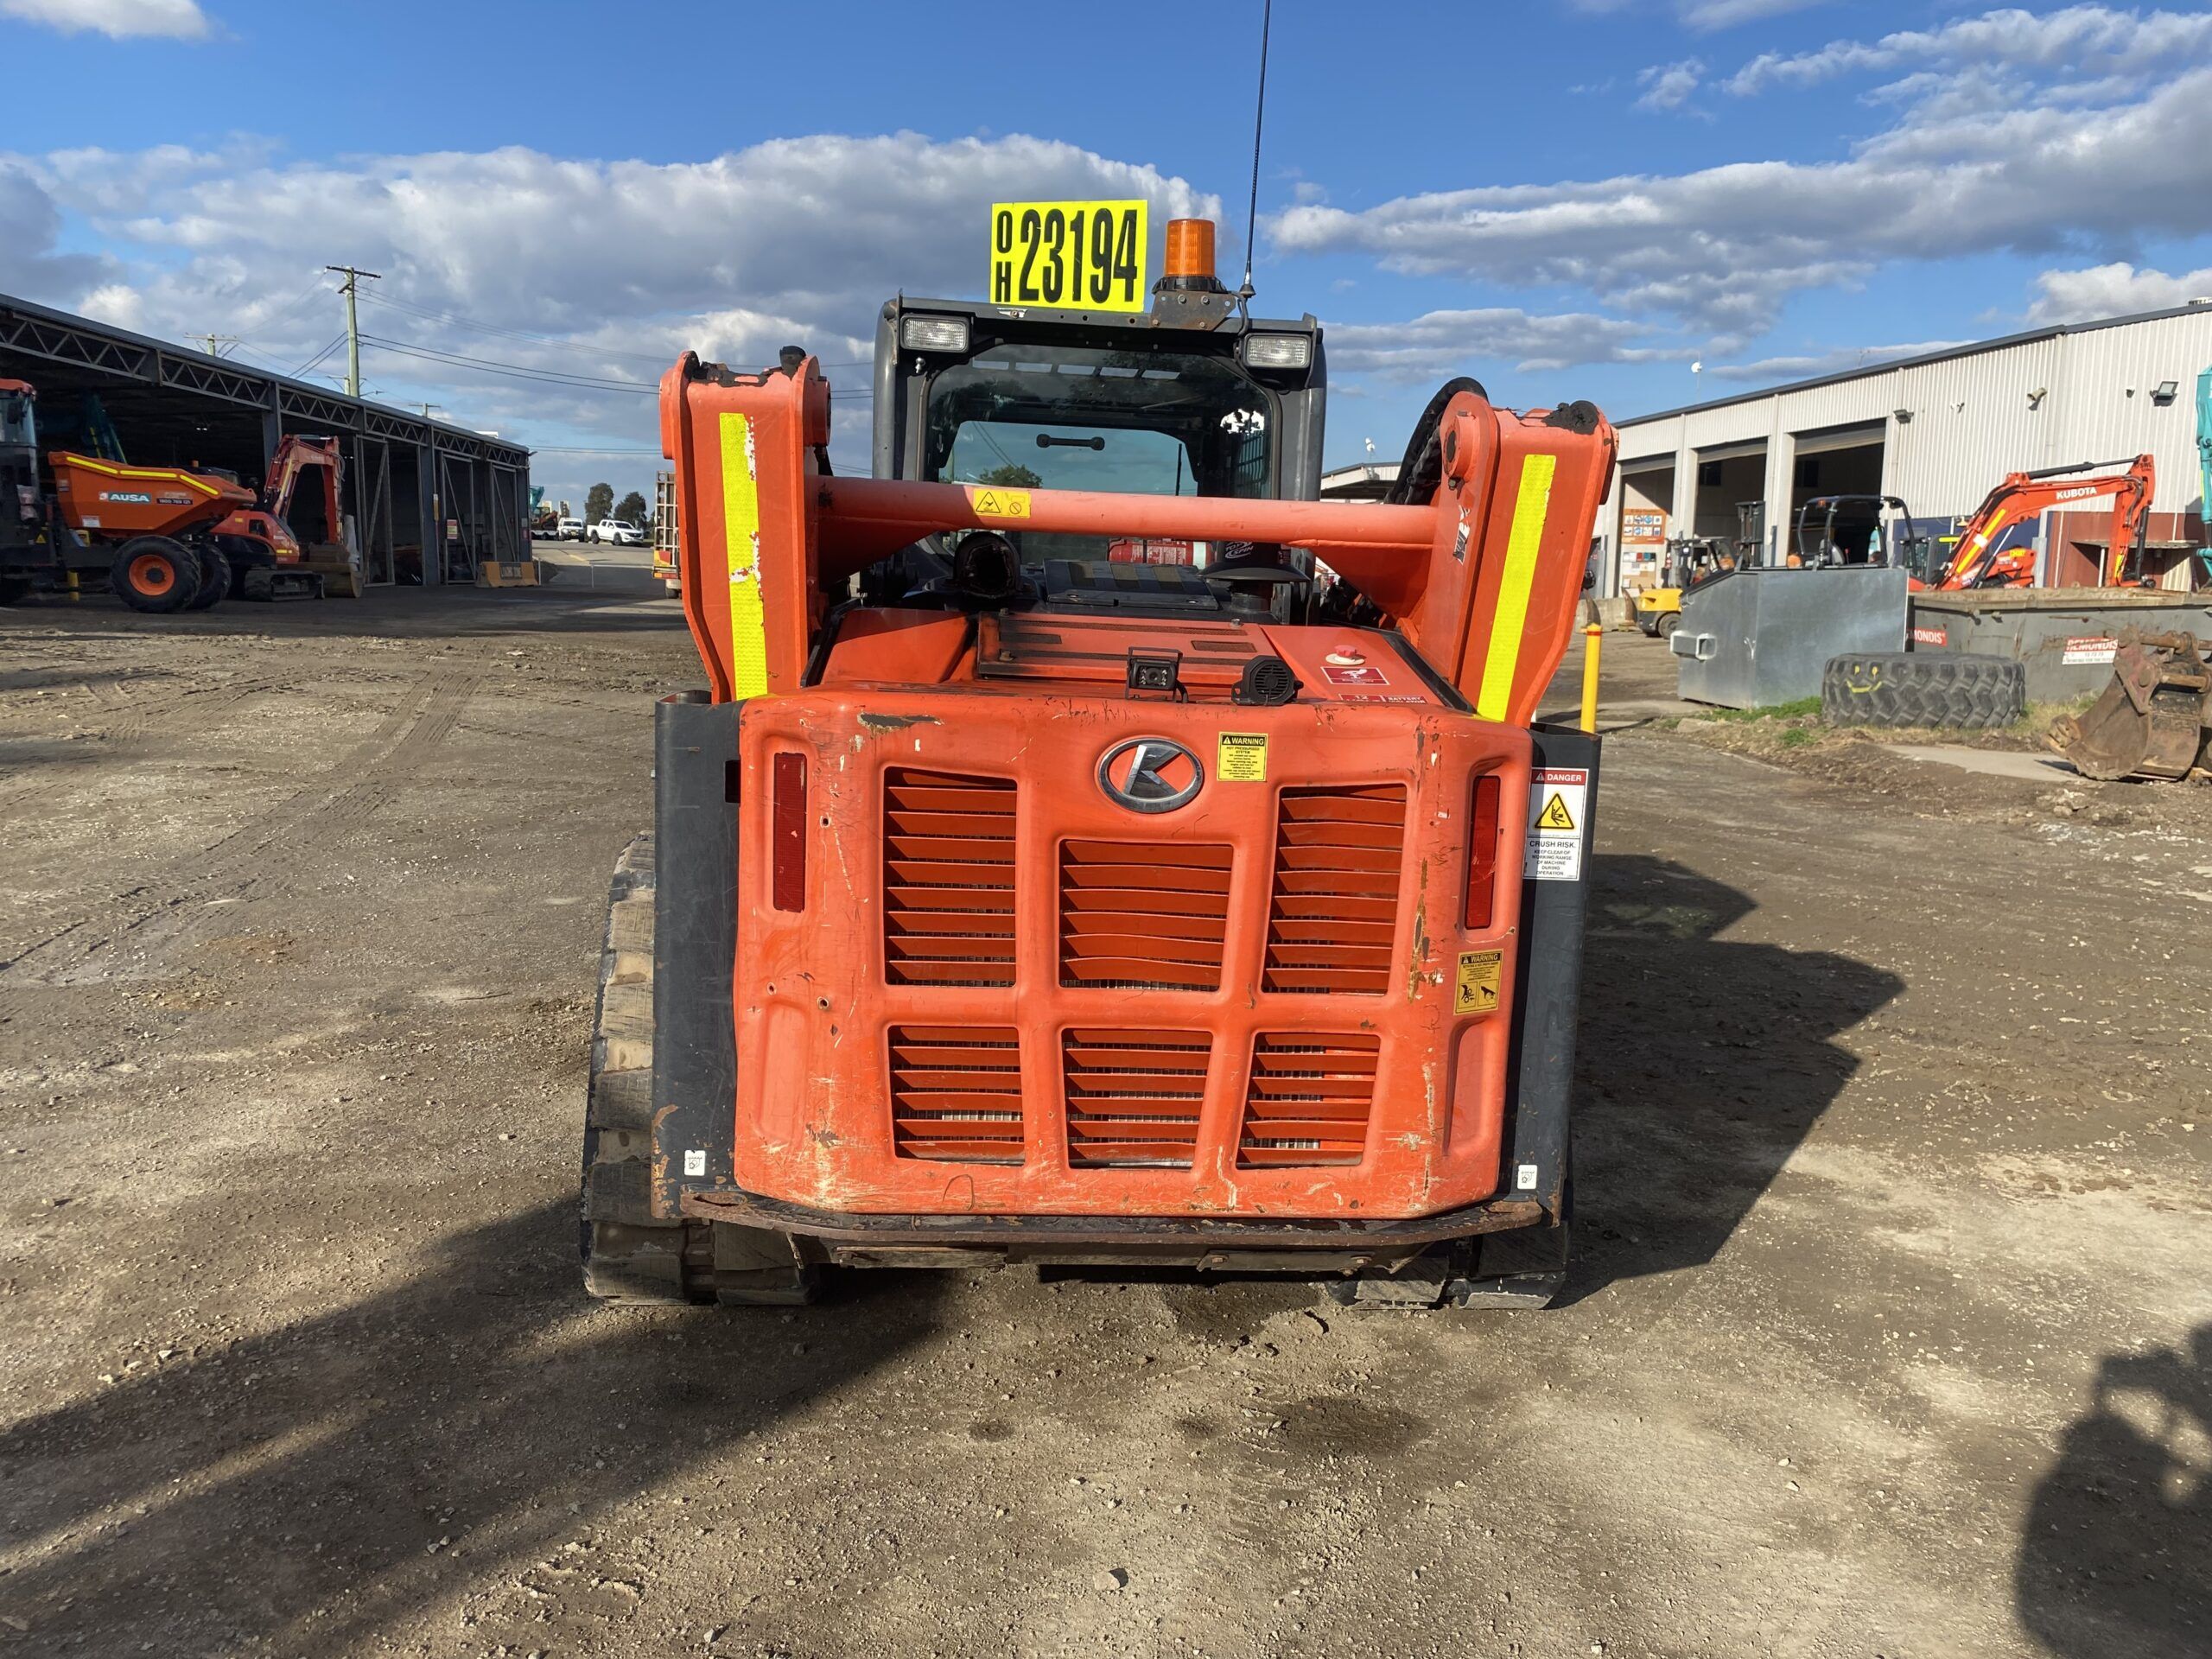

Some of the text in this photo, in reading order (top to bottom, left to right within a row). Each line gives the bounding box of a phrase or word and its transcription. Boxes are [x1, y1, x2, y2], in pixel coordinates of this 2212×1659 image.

[1019, 208, 1138, 304] 23194
[2056, 486, 2097, 499] KUBOTA
[110, 493, 150, 502] AUSA
[1231, 736, 1264, 745] WARNING
[1547, 773, 1582, 782] DANGER
[1471, 953, 1498, 963] WARNING
